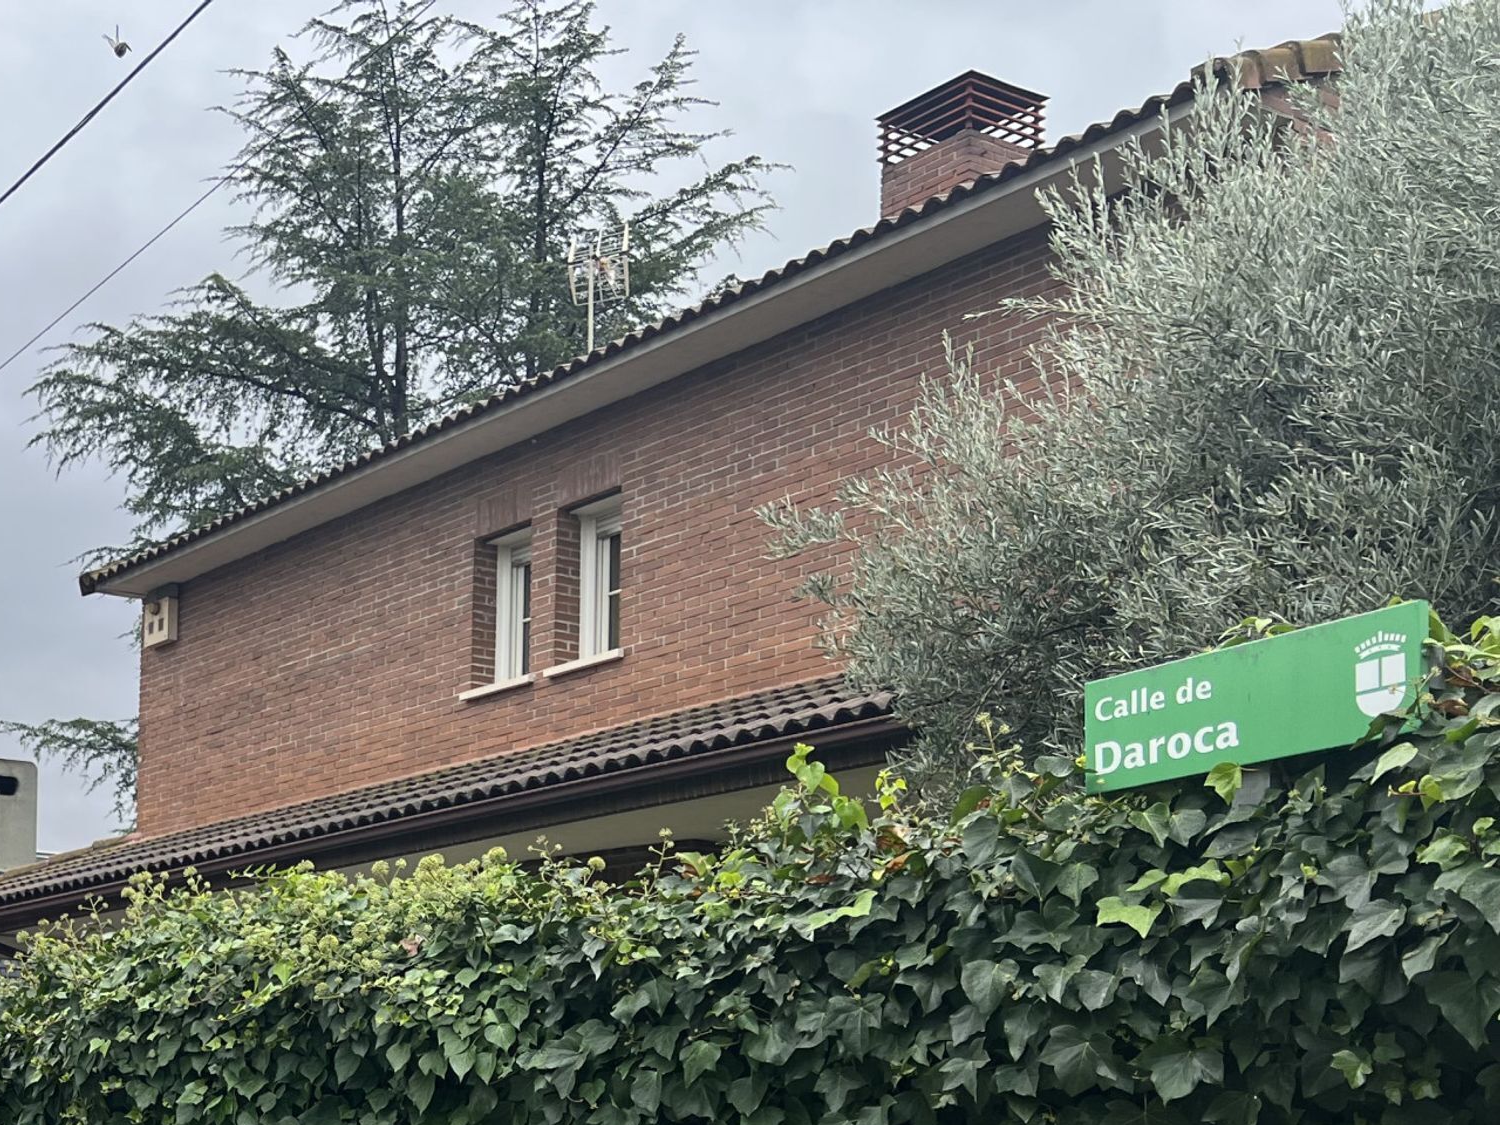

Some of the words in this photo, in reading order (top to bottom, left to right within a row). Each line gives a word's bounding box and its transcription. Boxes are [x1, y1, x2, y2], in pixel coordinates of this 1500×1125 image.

[1094, 686, 1165, 722] Calle
[1176, 677, 1212, 705] de
[1094, 721, 1239, 776] Daroca
